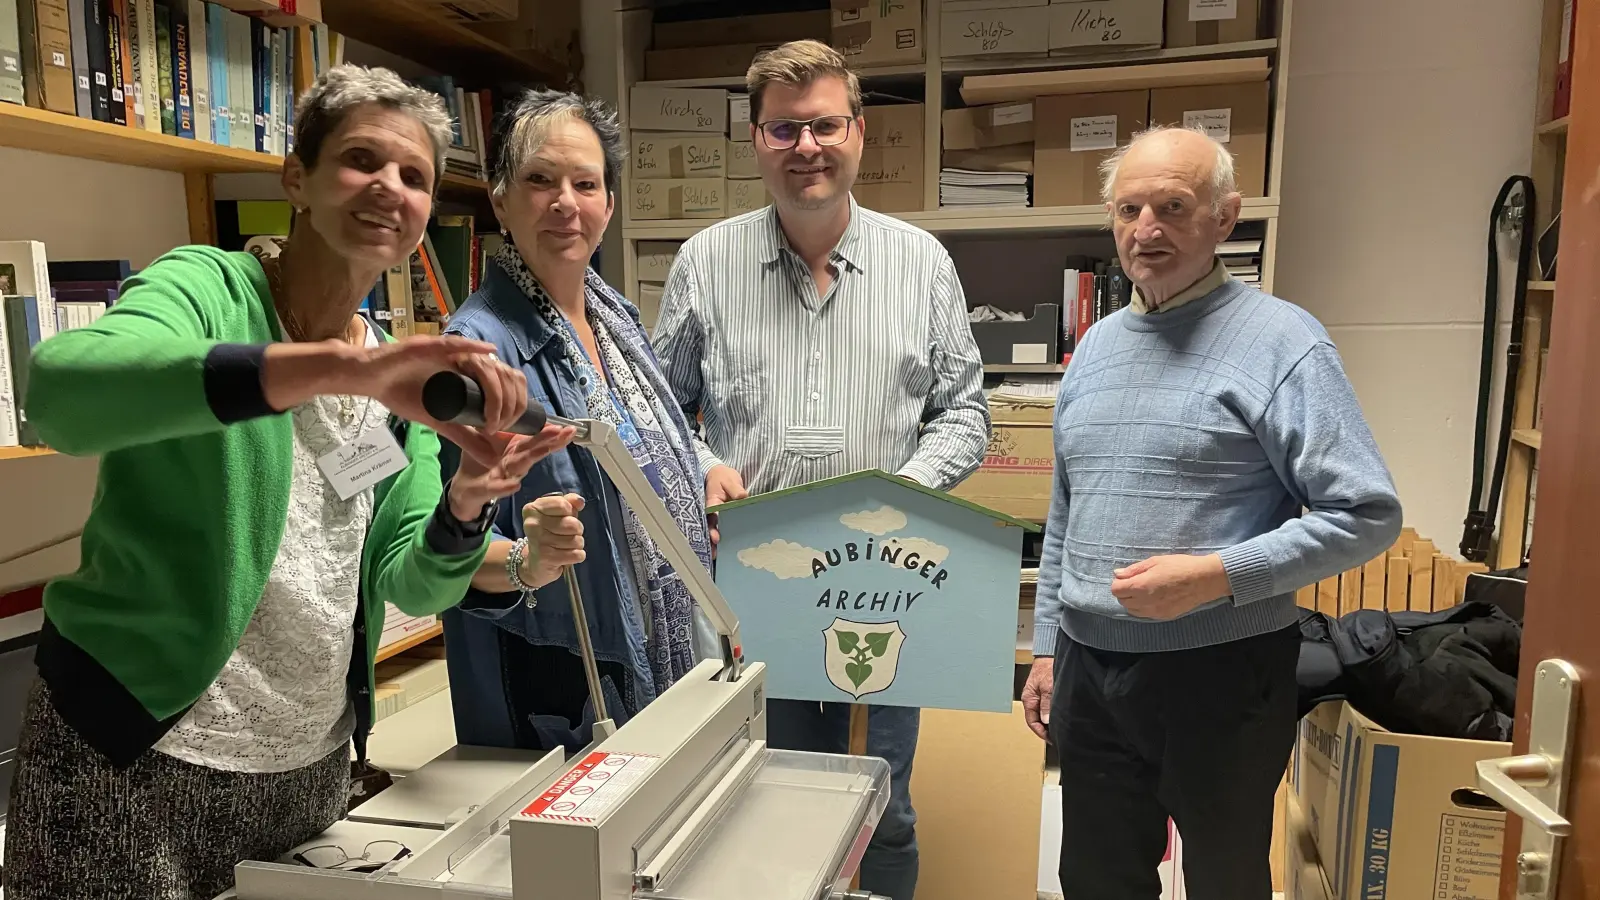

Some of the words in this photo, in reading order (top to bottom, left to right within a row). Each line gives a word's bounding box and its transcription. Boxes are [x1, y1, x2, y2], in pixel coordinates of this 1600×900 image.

[1101, 30, 1122, 41] 80
[982, 39, 999, 50] 80
[177, 24, 189, 96] AJUWAREN
[660, 97, 703, 116] Kirche
[181, 109, 191, 129] DIE
[697, 117, 712, 128] 80
[638, 142, 654, 154] 60
[636, 183, 652, 195] 60
[1024, 458, 1055, 466] DIREK
[350, 468, 372, 482] Martina
[553, 769, 585, 795] DANGER
[1371, 828, 1389, 850] KG
[1369, 855, 1386, 873] 30
